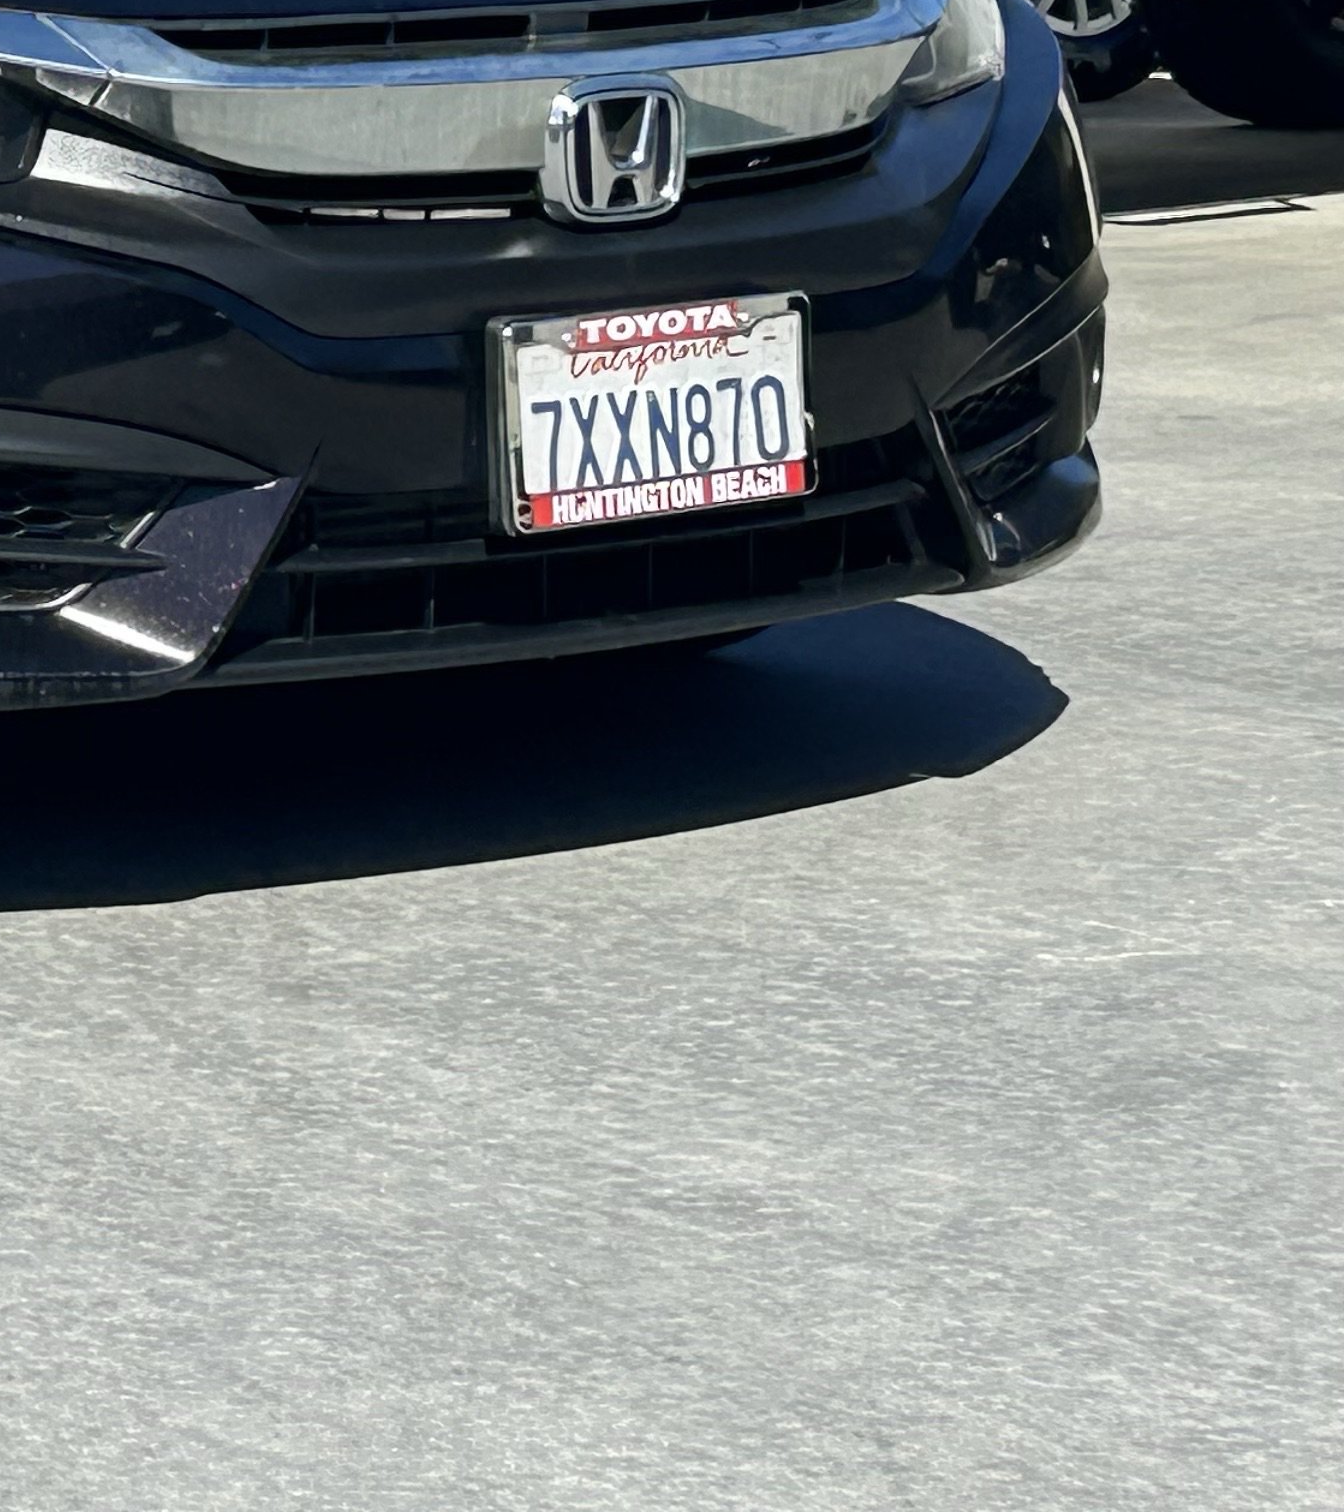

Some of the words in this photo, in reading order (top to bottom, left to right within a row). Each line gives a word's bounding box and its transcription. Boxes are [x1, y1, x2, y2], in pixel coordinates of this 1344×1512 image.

[579, 304, 738, 345] TOYOTA
[530, 374, 791, 492] 7XXN870
[551, 474, 706, 525] HUNTINGTON
[715, 463, 788, 504] BEACH
